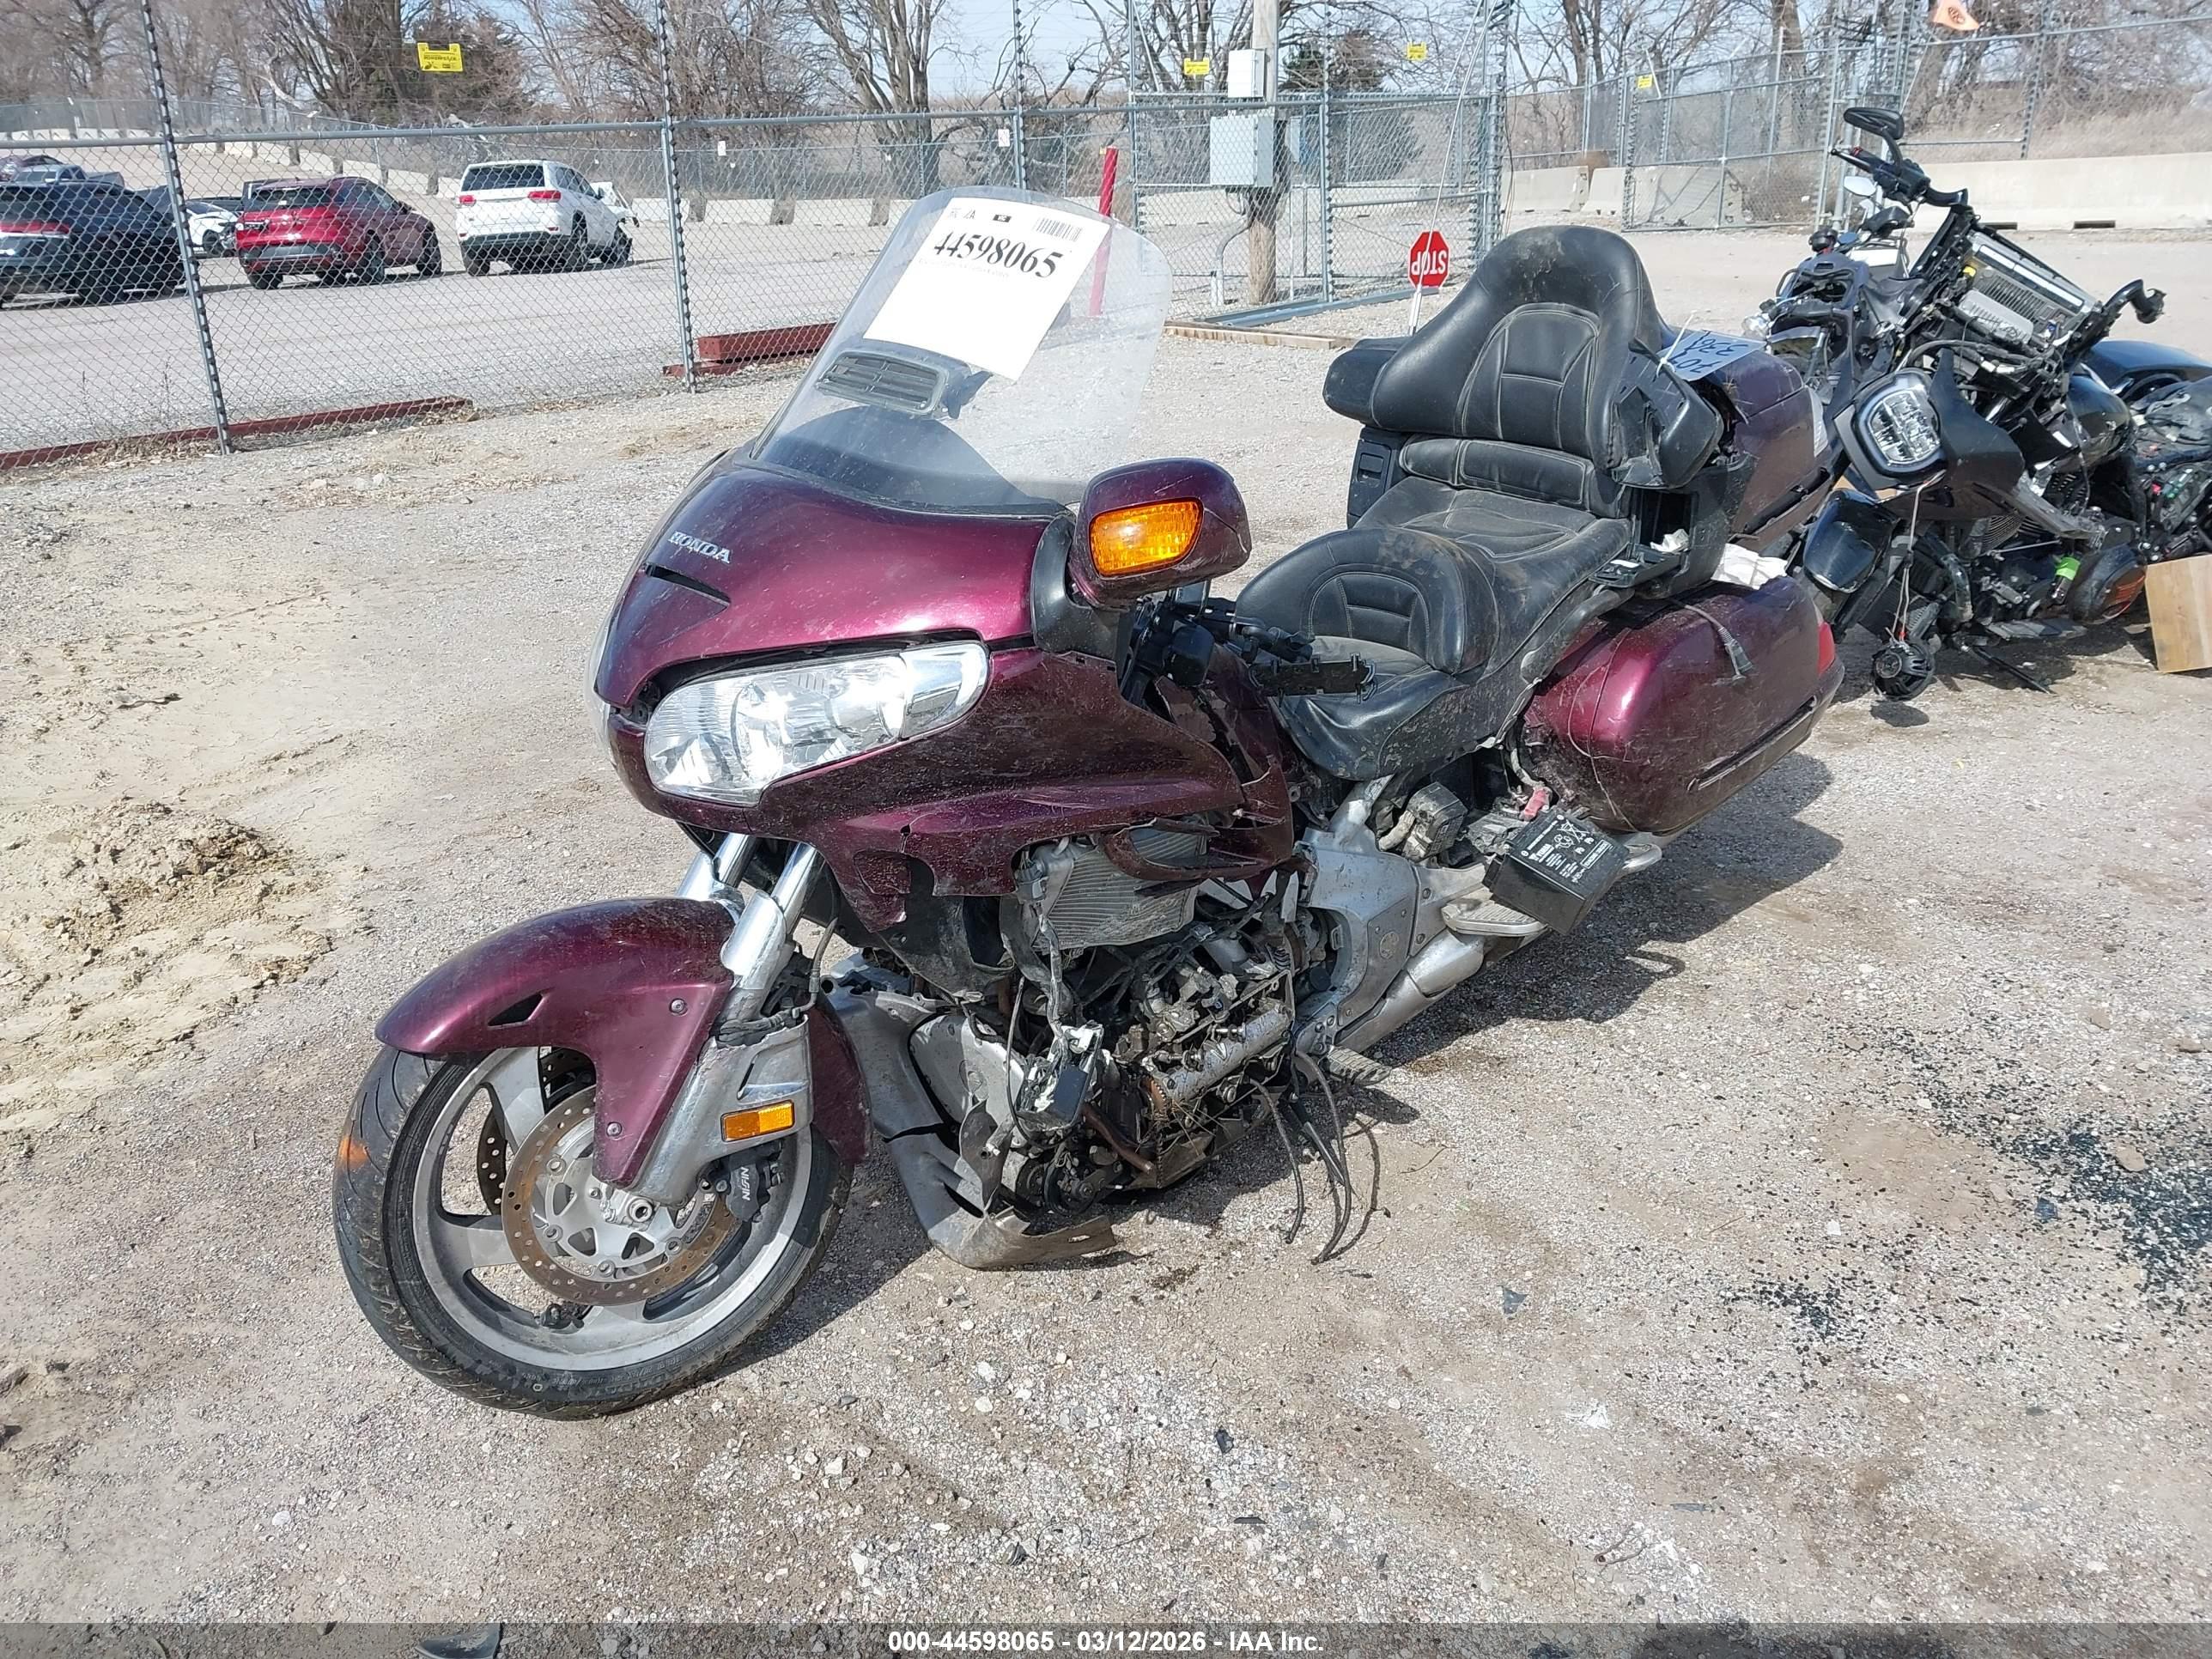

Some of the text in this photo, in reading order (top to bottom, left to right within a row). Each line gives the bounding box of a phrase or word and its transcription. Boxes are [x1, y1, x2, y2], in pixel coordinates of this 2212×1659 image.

[934, 231, 1064, 278] 44598065
[1411, 250, 1448, 276] STOP
[667, 531, 731, 564] HONDA
[741, 1166, 750, 1201] NISSIN
